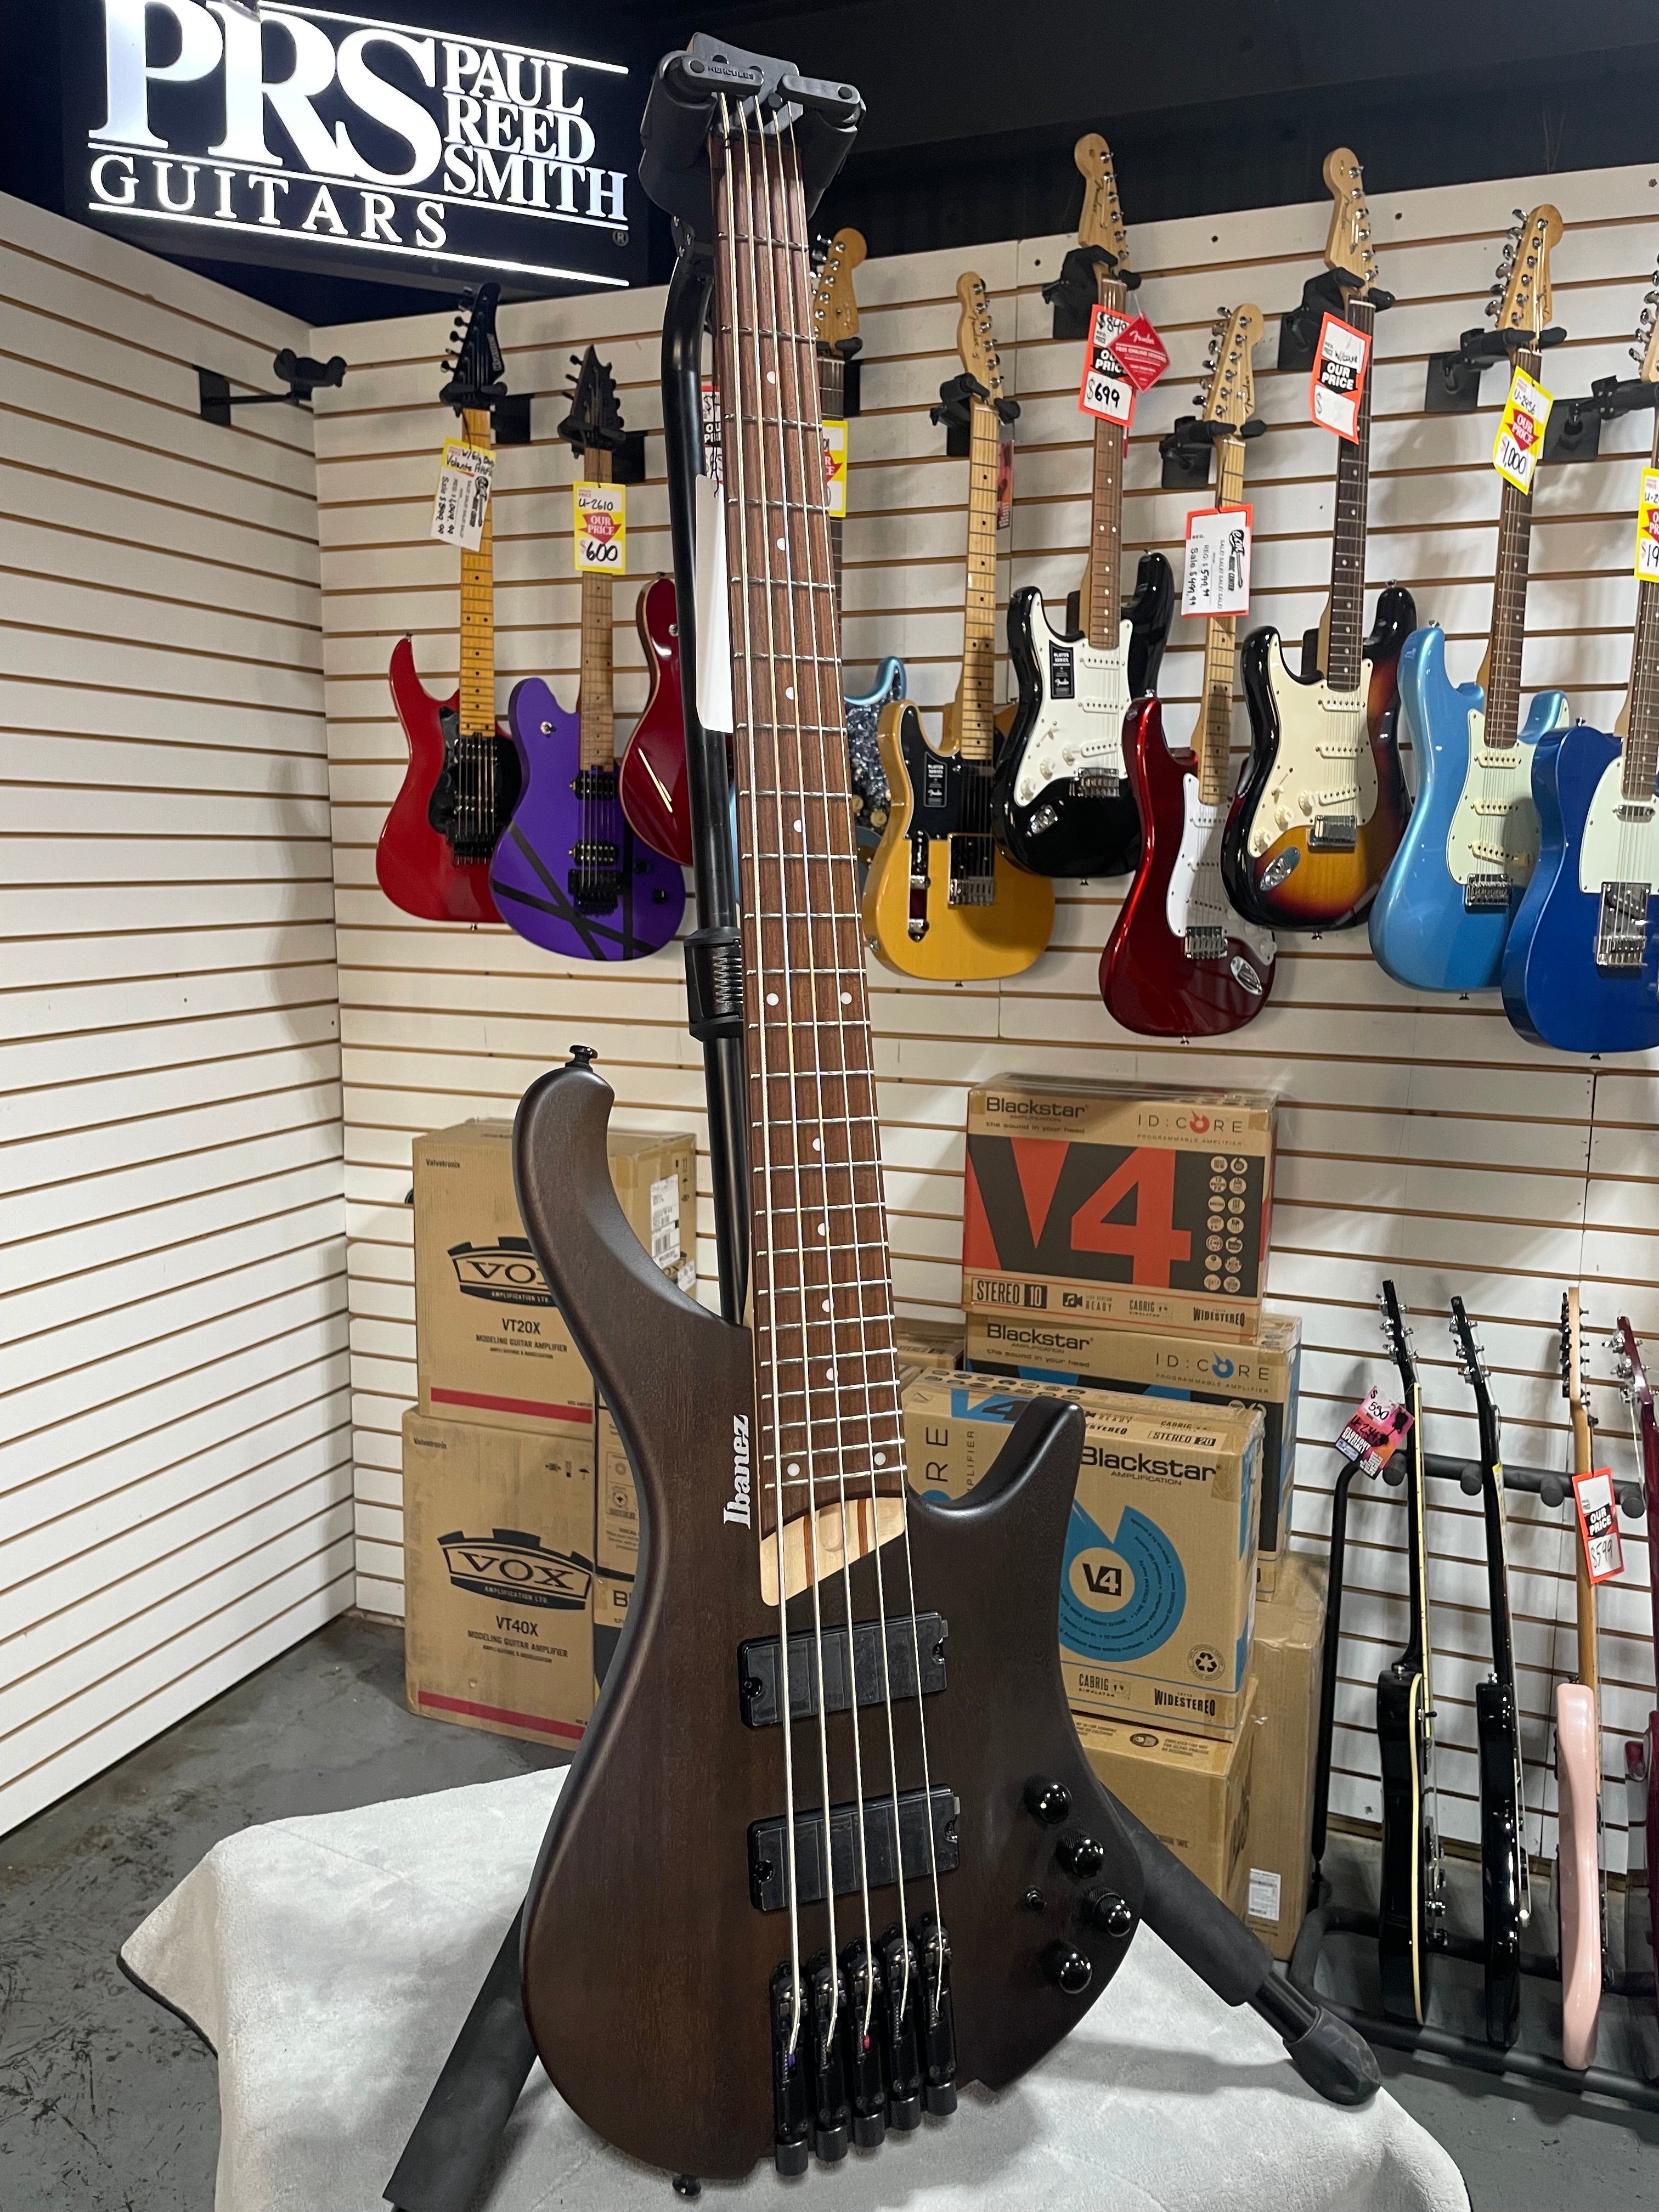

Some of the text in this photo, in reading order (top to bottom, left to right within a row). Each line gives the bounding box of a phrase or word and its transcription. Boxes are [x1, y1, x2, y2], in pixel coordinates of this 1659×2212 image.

[442, 41, 584, 115] PAUL
[708, 65, 754, 80] HERCULES
[88, 0, 442, 187] PRS
[443, 92, 595, 165] REED
[443, 144, 628, 221] SMITH
[91, 156, 447, 250] GUITARS
[1096, 359, 1123, 373] PRIC
[1327, 363, 1350, 377] OUR
[1322, 372, 1354, 390] PRICE
[1086, 379, 1120, 409] $699
[1512, 422, 1534, 445] PRICE
[1517, 414, 1533, 432] OUR
[587, 524, 615, 535] PRICE
[590, 515, 611, 525] OUR
[986, 1097, 1085, 1118] Blackstar
[1137, 1133, 1199, 1143] PROGRAMMABLE
[492, 1291, 535, 1302] AMPLIFICATION
[977, 1280, 1041, 1307] STEREO 10
[1085, 1300, 1113, 1312] READY
[1129, 1300, 1155, 1312] CABRIG
[502, 1317, 541, 1335] VT20X
[1193, 1307, 1245, 1327] WIDESTEREO
[476, 1334, 568, 1353] MODELING GUITAR AMPLIFIER
[988, 1323, 1090, 1351] Blackstar
[986, 1348, 1002, 1356] the
[1005, 1351, 1032, 1360] sound
[1045, 1355, 1066, 1365] your
[1068, 1358, 1090, 1368] head
[1155, 1373, 1269, 1394] PROGRAMMABLE AMPLIFIER
[1153, 1431, 1214, 1446] STEREO 20
[966, 1430, 975, 1491] PLIFIER
[1081, 1446, 1216, 1481] Blackstar
[723, 1414, 751, 1530] Ibanez
[1110, 1470, 1182, 1486] AMPLIFICATION
[1589, 1515, 1612, 1536] PRICE
[1590, 1507, 1607, 1524] OUR
[1591, 1539, 1613, 1568] $599
[459, 1551, 574, 1590] VOX
[1082, 1562, 1122, 1596] V4
[496, 1615, 539, 1637] VT40X
[468, 1630, 503, 1644] MODELING
[504, 1638, 529, 1650] GUITAR
[531, 1644, 568, 1657] AMPLIFIER
[1079, 1674, 1109, 1691] CABRIG
[1154, 1688, 1216, 1717] WIDESTEREO
